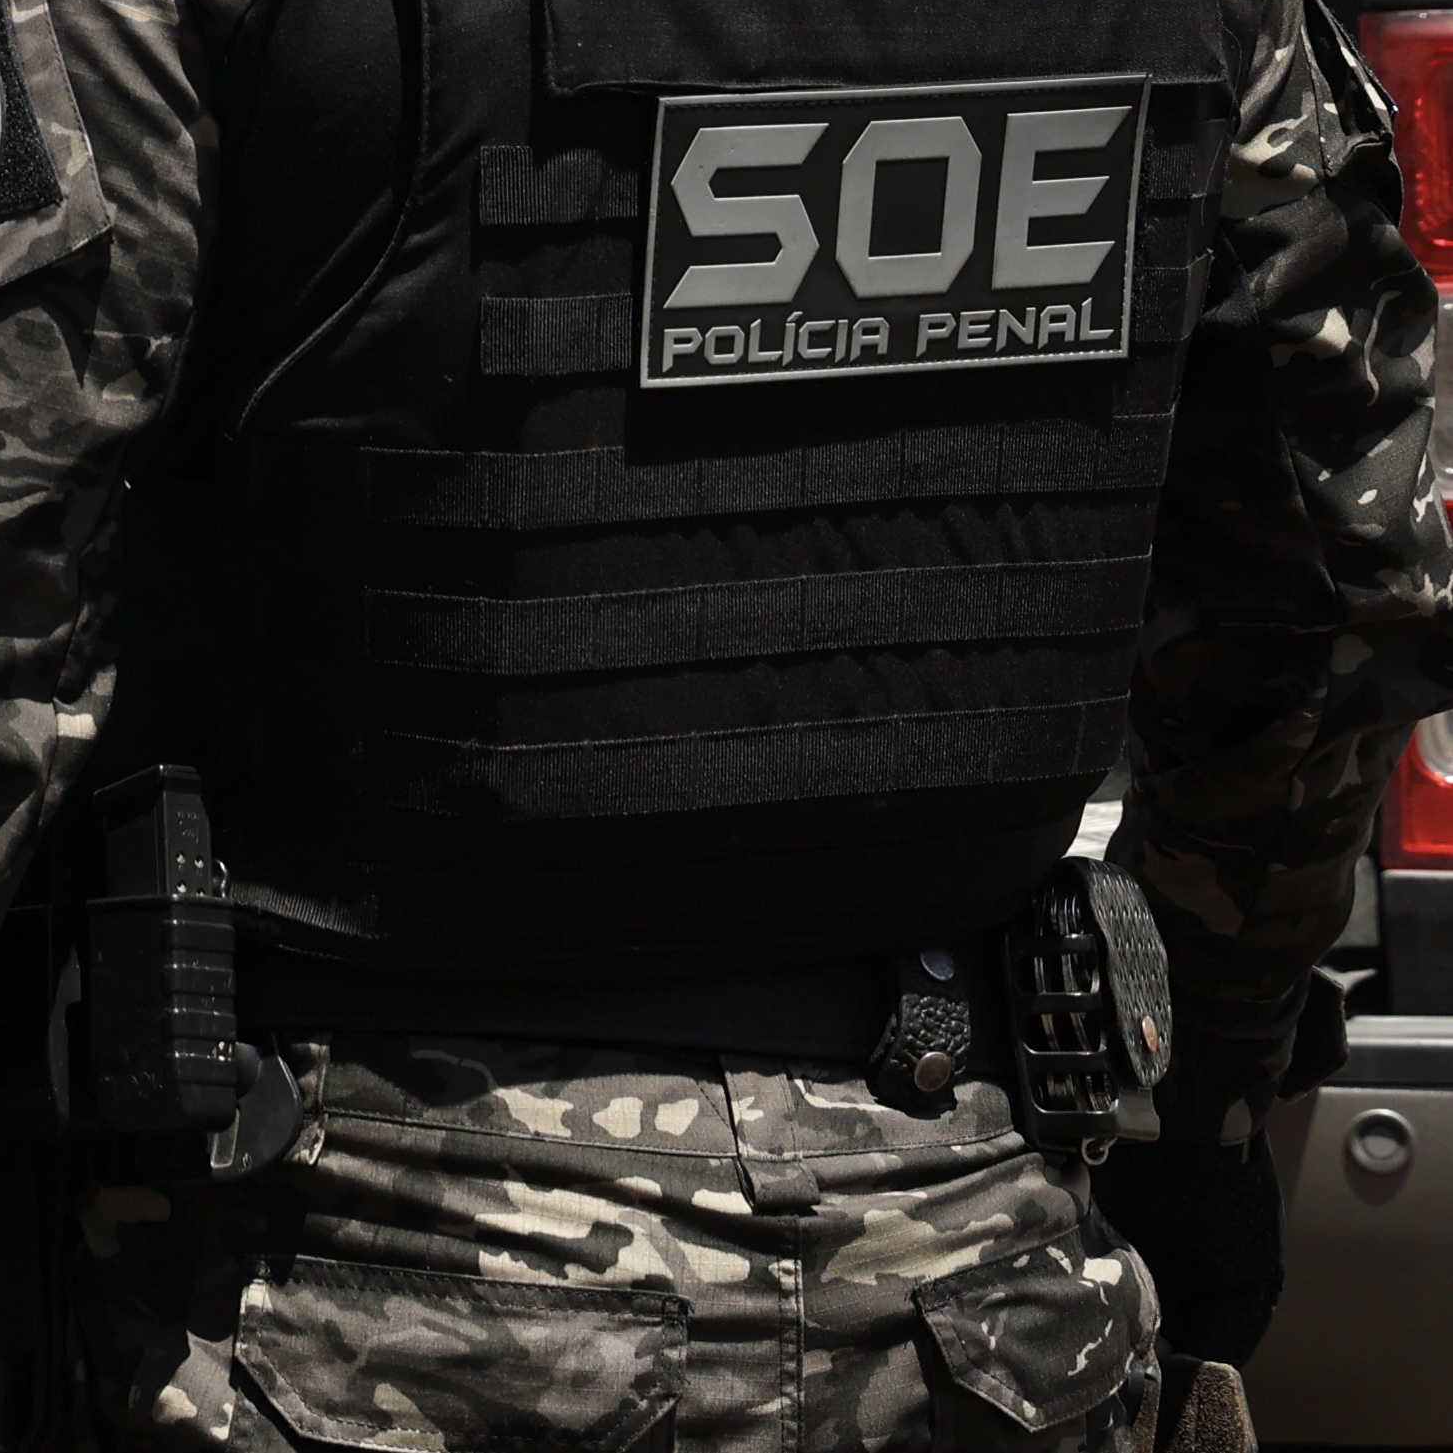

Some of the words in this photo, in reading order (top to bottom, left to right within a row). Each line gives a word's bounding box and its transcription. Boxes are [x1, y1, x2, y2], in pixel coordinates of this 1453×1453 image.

[662, 105, 1133, 310] SOE
[662, 311, 890, 373] POLÍCIA
[916, 297, 1115, 357] PENAL
